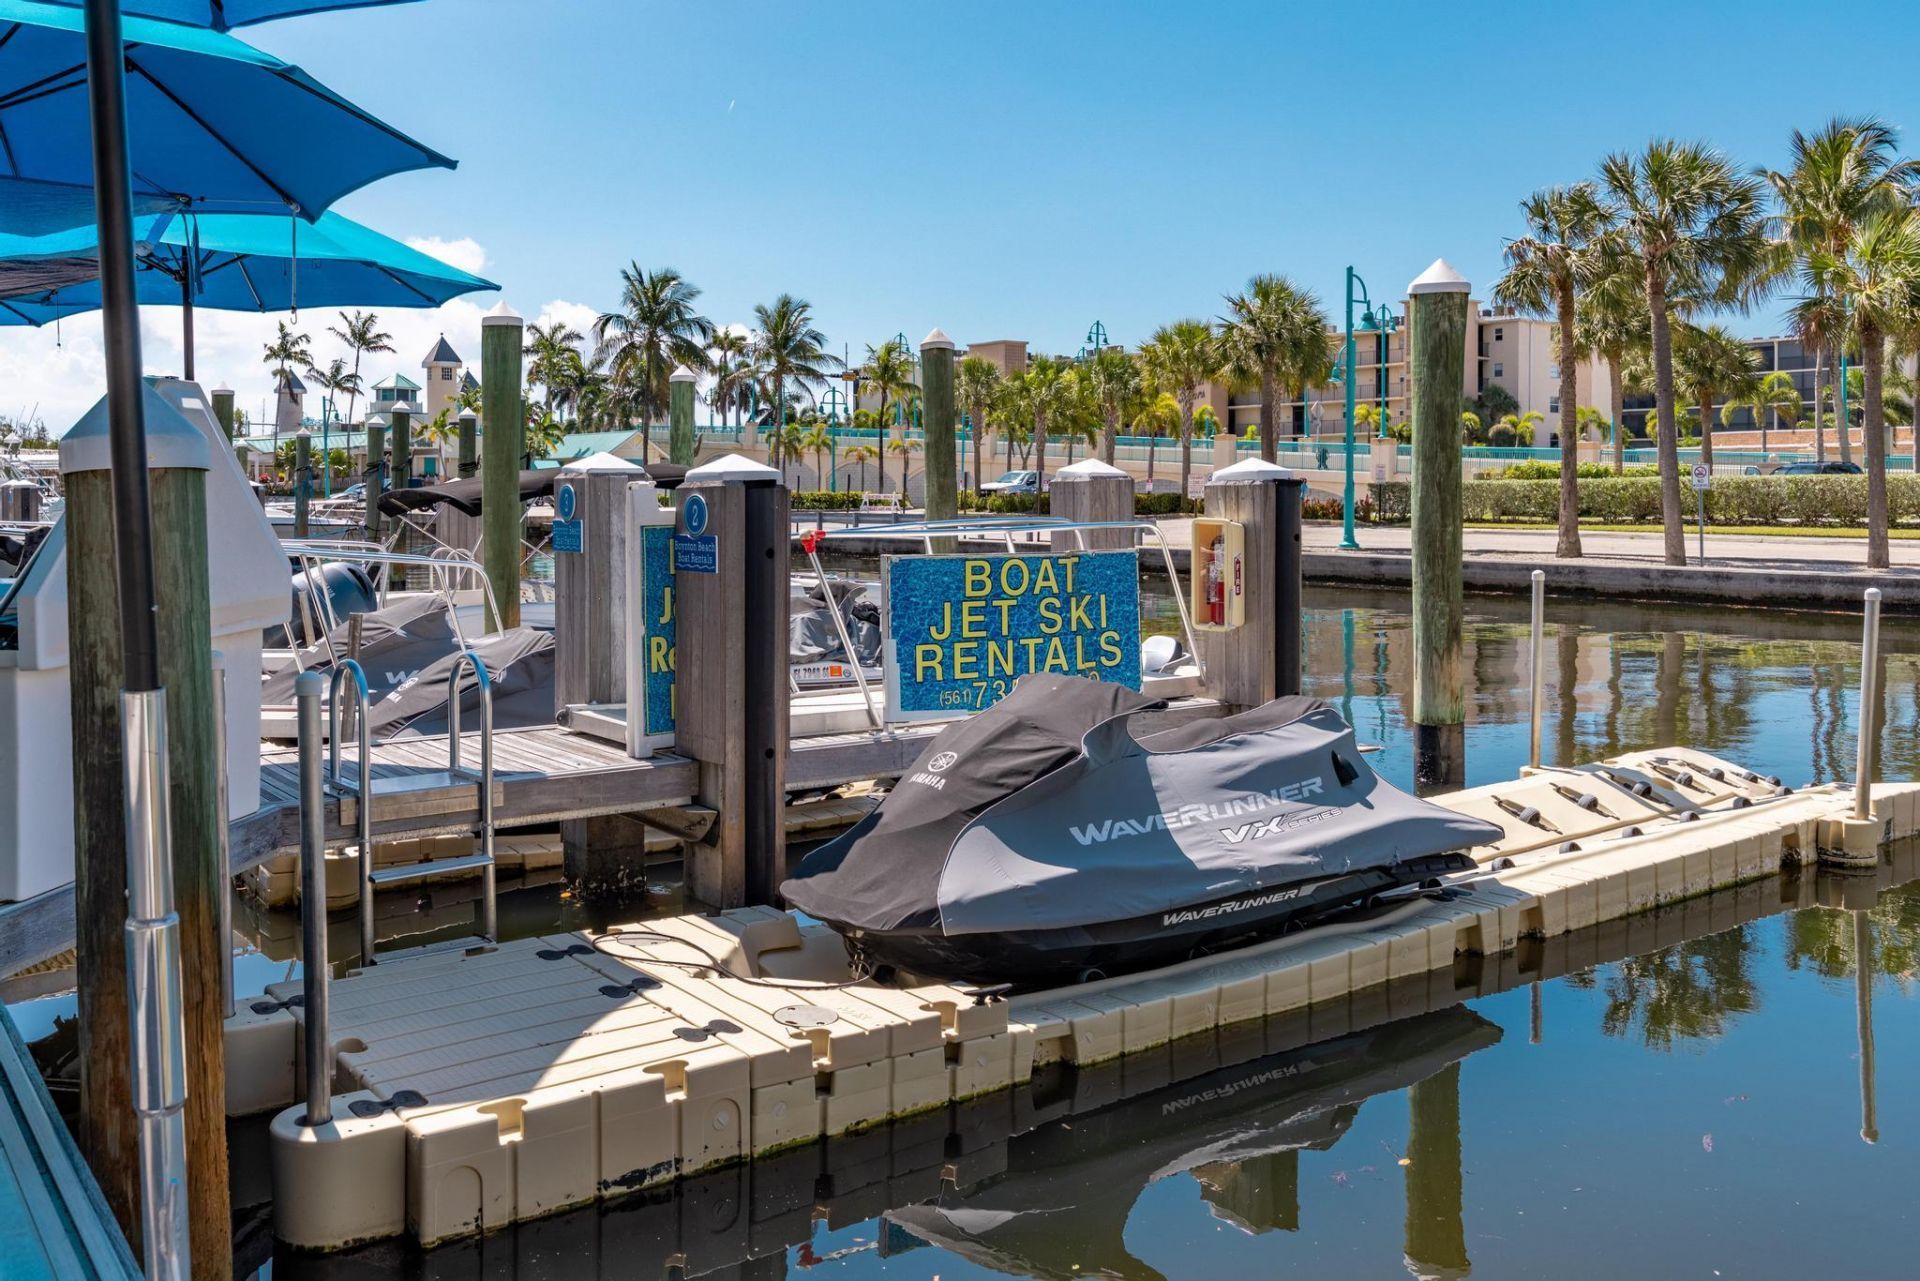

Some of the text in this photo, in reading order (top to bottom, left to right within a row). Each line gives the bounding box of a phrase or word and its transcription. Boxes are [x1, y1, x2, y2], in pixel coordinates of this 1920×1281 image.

[692, 505, 698, 526] 2
[678, 552, 713, 565] Boat Rentals
[698, 541, 716, 552] Beach
[964, 556, 1079, 598] BOAT
[929, 593, 1107, 641] JET SKI
[915, 630, 1122, 683] RENTALS
[1069, 776, 1324, 846] WAVERUNNER
[1219, 814, 1285, 844] VX
[1162, 889, 1299, 927] WAVERUNNER
